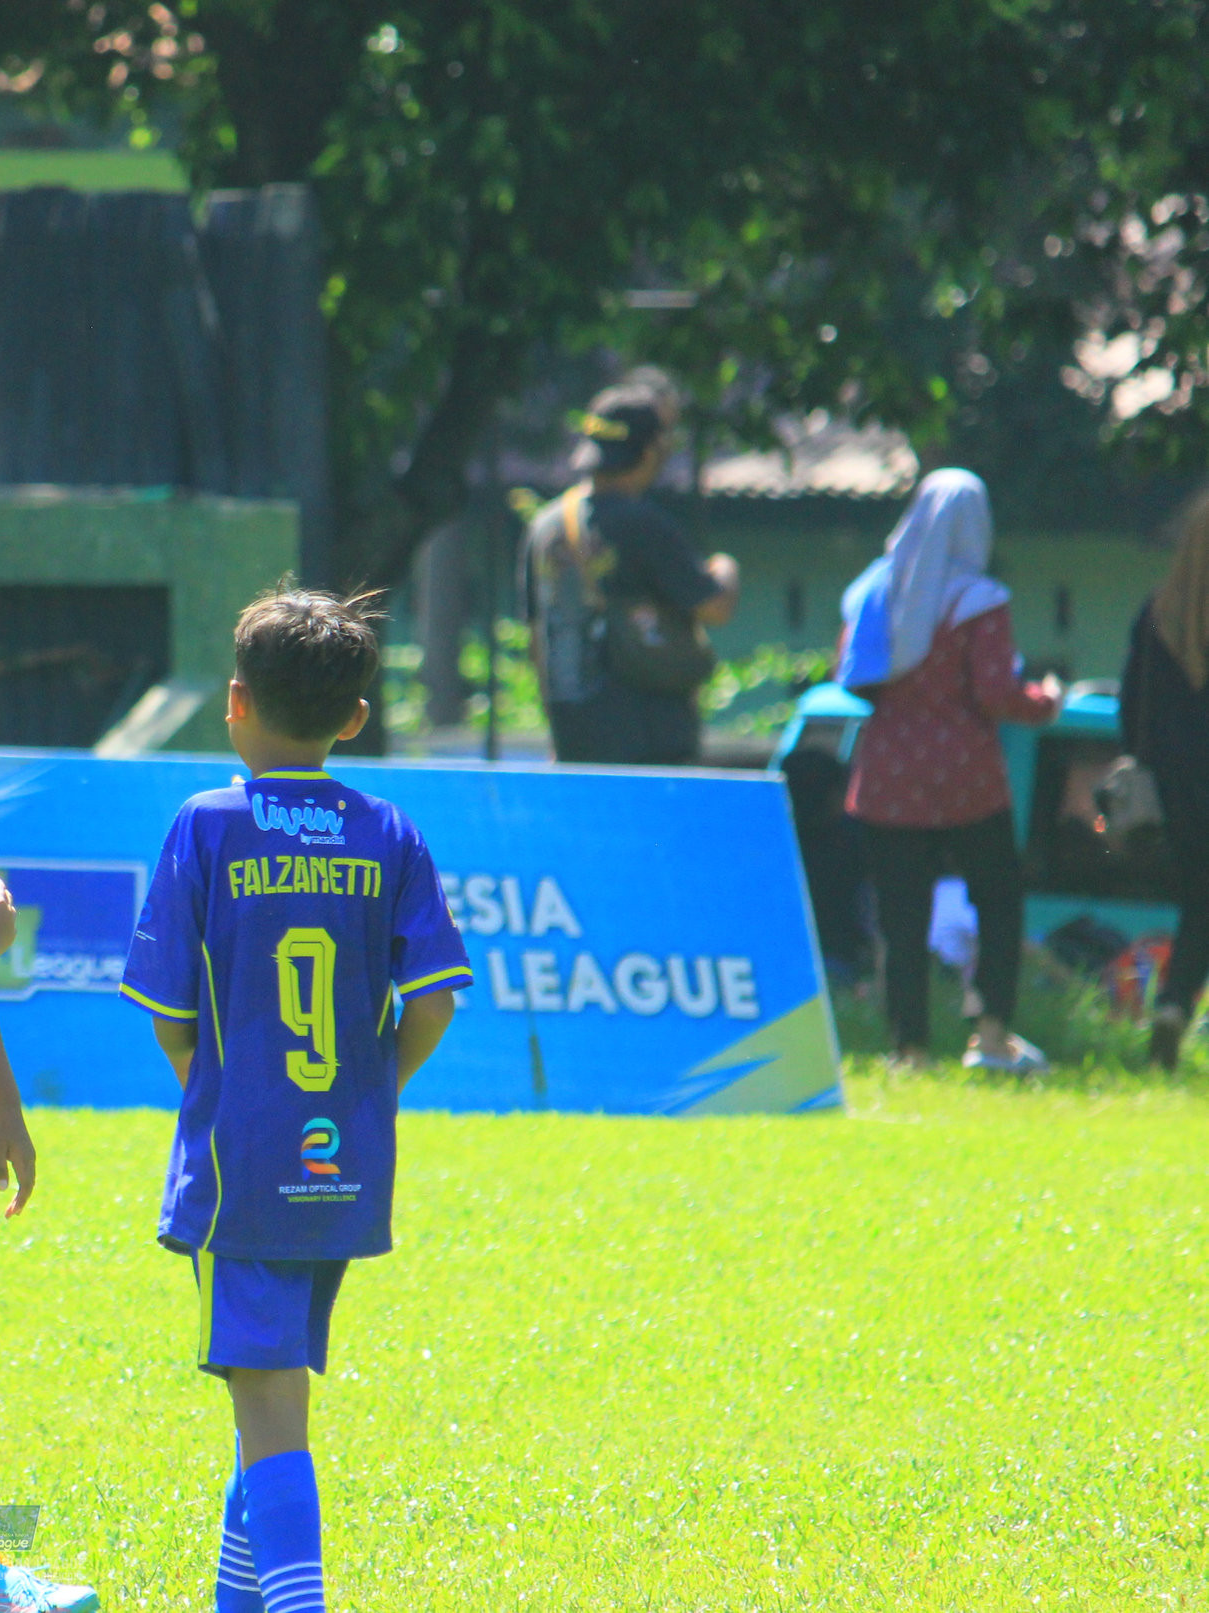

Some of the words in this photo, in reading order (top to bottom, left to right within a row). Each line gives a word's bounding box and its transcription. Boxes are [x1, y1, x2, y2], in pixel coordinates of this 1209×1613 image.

[228, 855, 382, 899] FALZANETTI
[272, 927, 342, 1092] 9
[487, 948, 760, 1020] LEAGUE
[309, 1184, 338, 1193] OPTICAL
